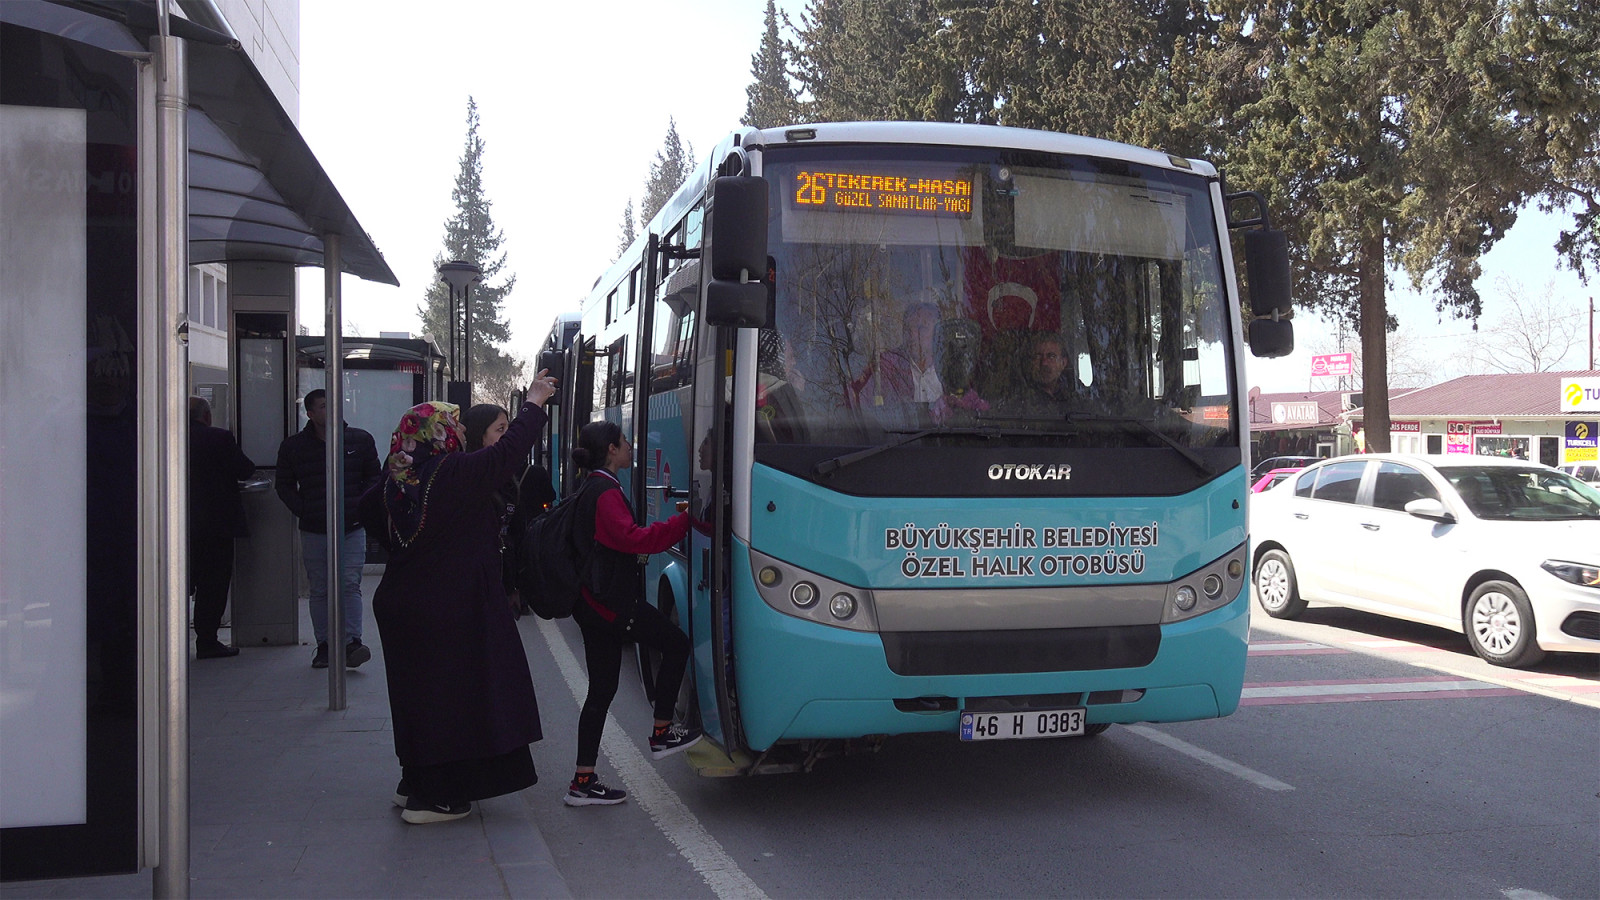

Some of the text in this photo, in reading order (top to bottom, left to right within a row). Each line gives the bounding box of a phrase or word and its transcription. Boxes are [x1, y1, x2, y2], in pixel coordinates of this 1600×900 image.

[796, 171, 826, 205] 26
[835, 191, 873, 207] GÜZEL
[1287, 405, 1316, 420] AVATAR
[1401, 423, 1418, 431] PERDE
[987, 464, 1072, 480] OTOKAR
[886, 521, 1159, 553] BÜYÜKŞEHİR BELEDİYESİ
[901, 549, 1145, 578] ÖZEL HALK OTOBÜSÜ
[963, 728, 972, 736] TR
[976, 712, 1080, 736] 46 H 0383
